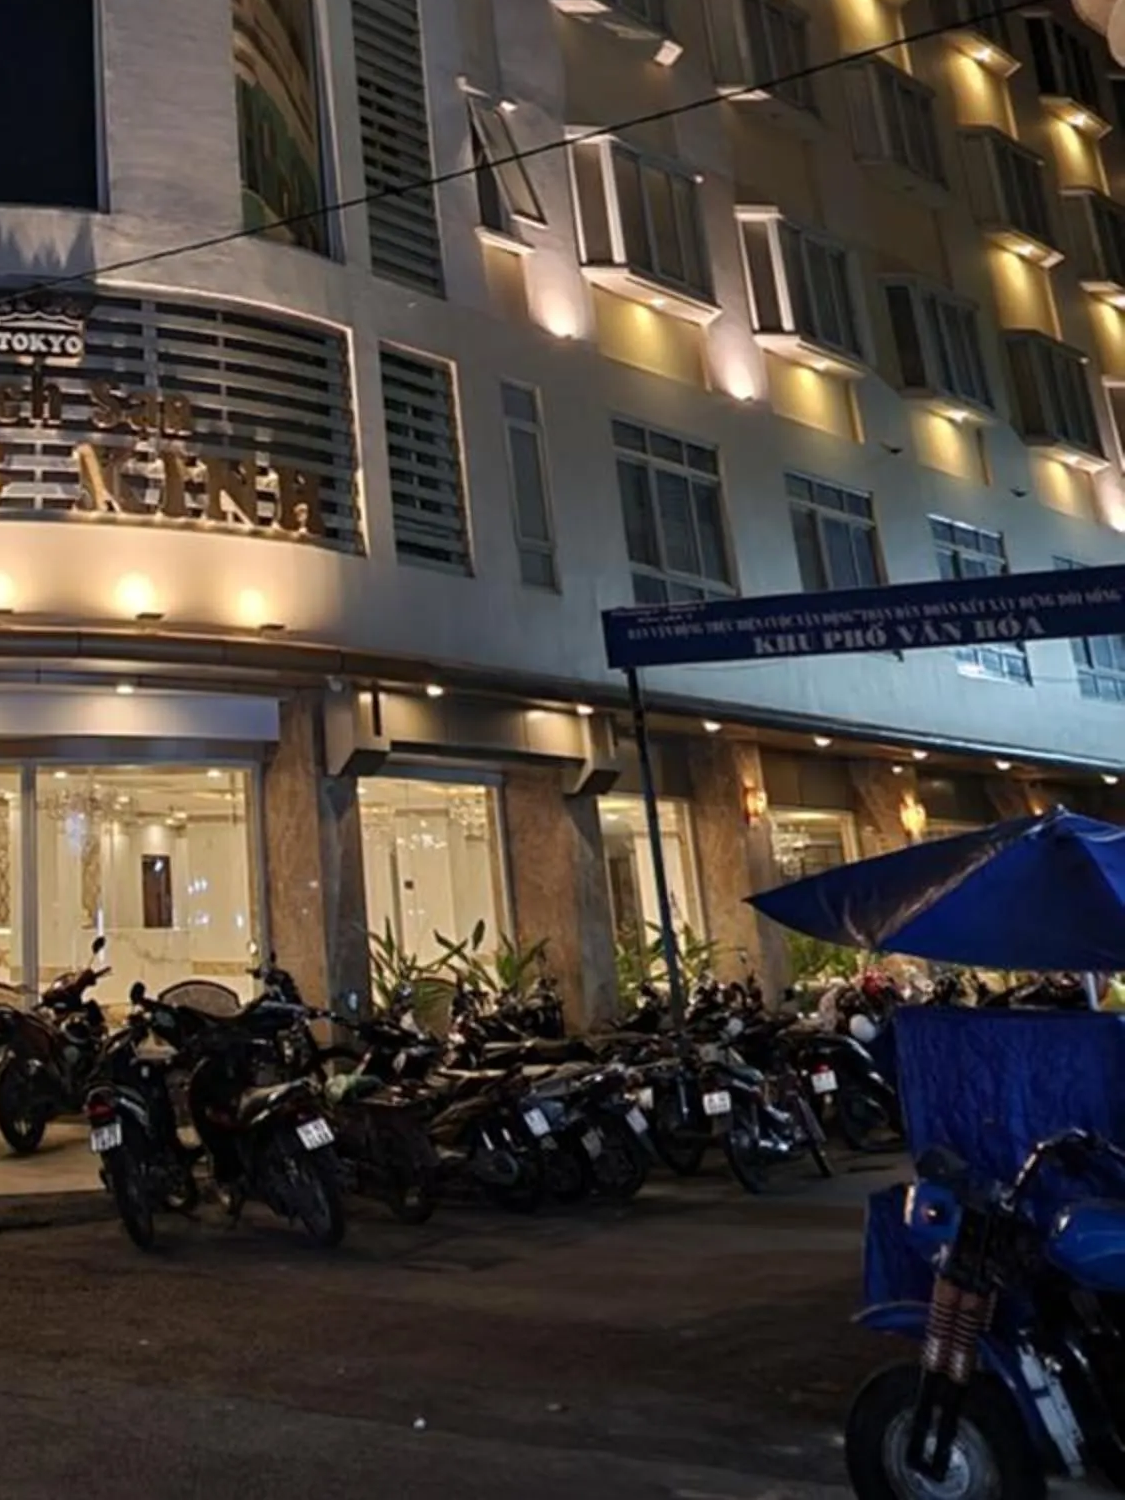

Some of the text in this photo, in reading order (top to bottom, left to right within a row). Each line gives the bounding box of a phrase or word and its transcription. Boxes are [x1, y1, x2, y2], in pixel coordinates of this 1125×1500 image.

[753, 633, 813, 656] KHU
[822, 619, 888, 650] PHỐ
[896, 616, 963, 645] VĂN
[972, 612, 1048, 639] HÓA
